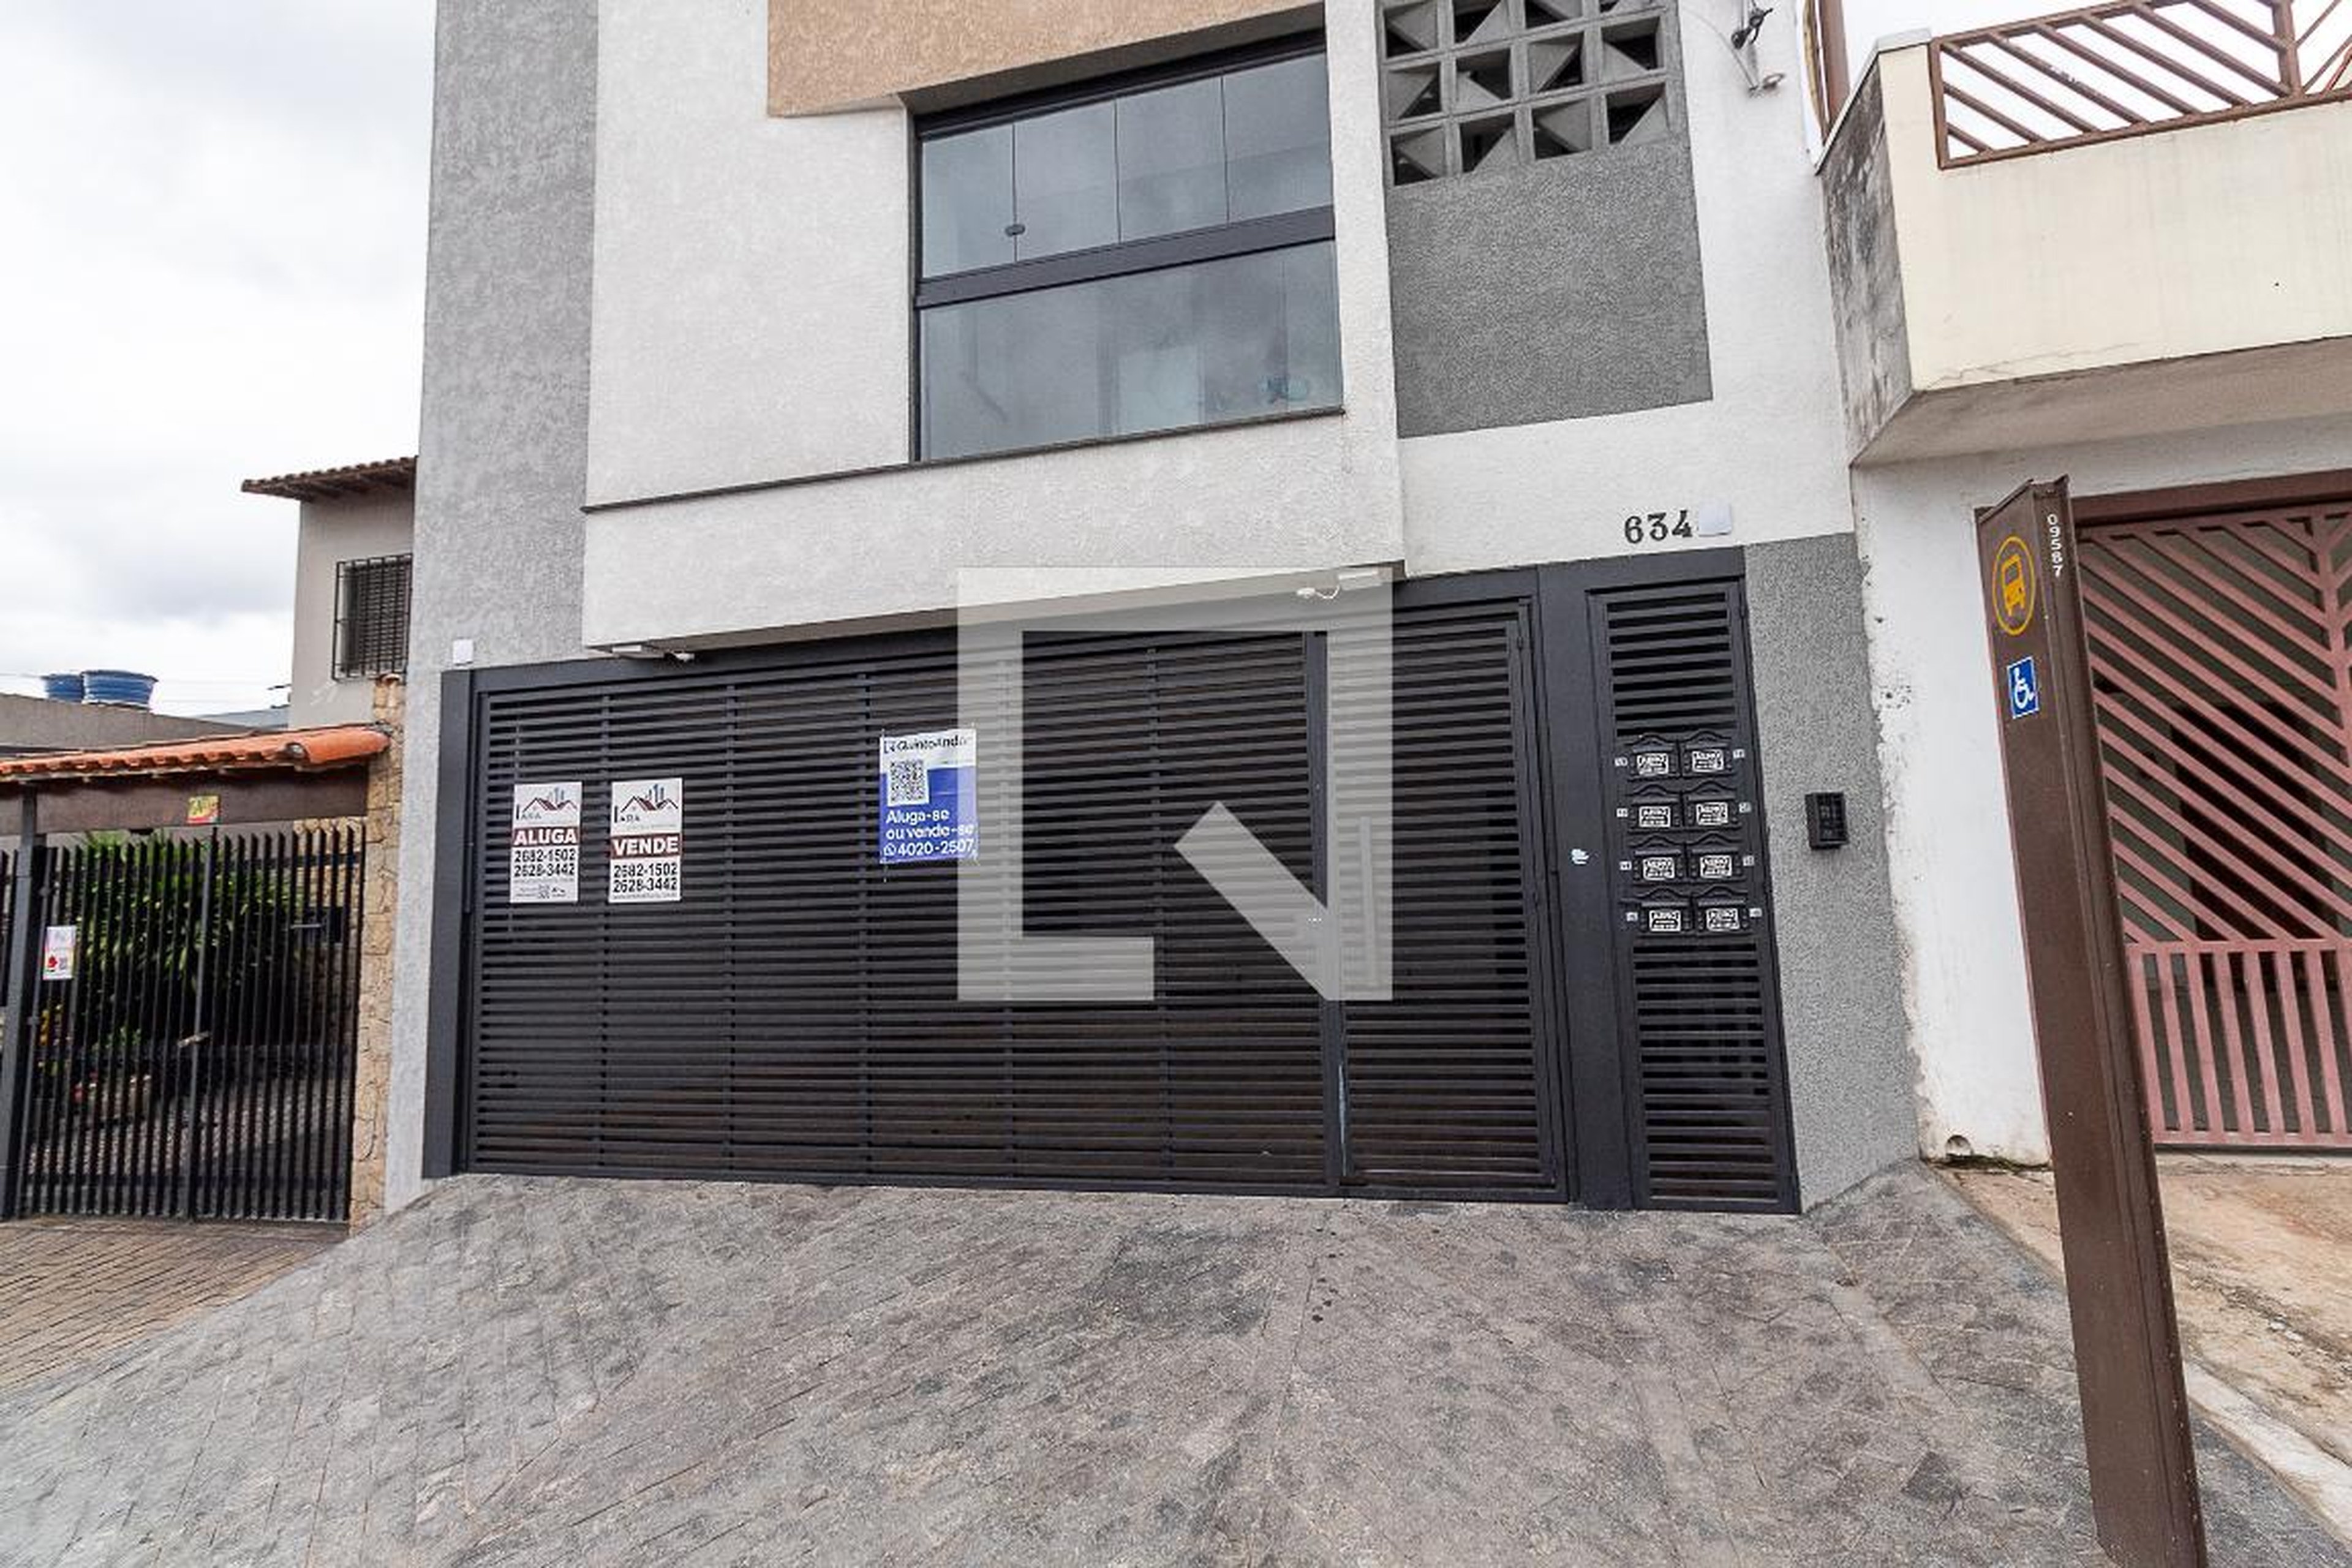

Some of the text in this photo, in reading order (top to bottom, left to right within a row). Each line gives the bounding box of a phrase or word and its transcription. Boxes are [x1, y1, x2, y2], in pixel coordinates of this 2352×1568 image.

[1624, 510, 1693, 544] 634
[2047, 513, 2064, 578] 09587
[886, 809, 950, 825] Aluga-se
[514, 829, 576, 845] ALUGA
[886, 828, 905, 840] ou
[613, 835, 679, 856] VENDE
[898, 838, 974, 856] 4020-2507
